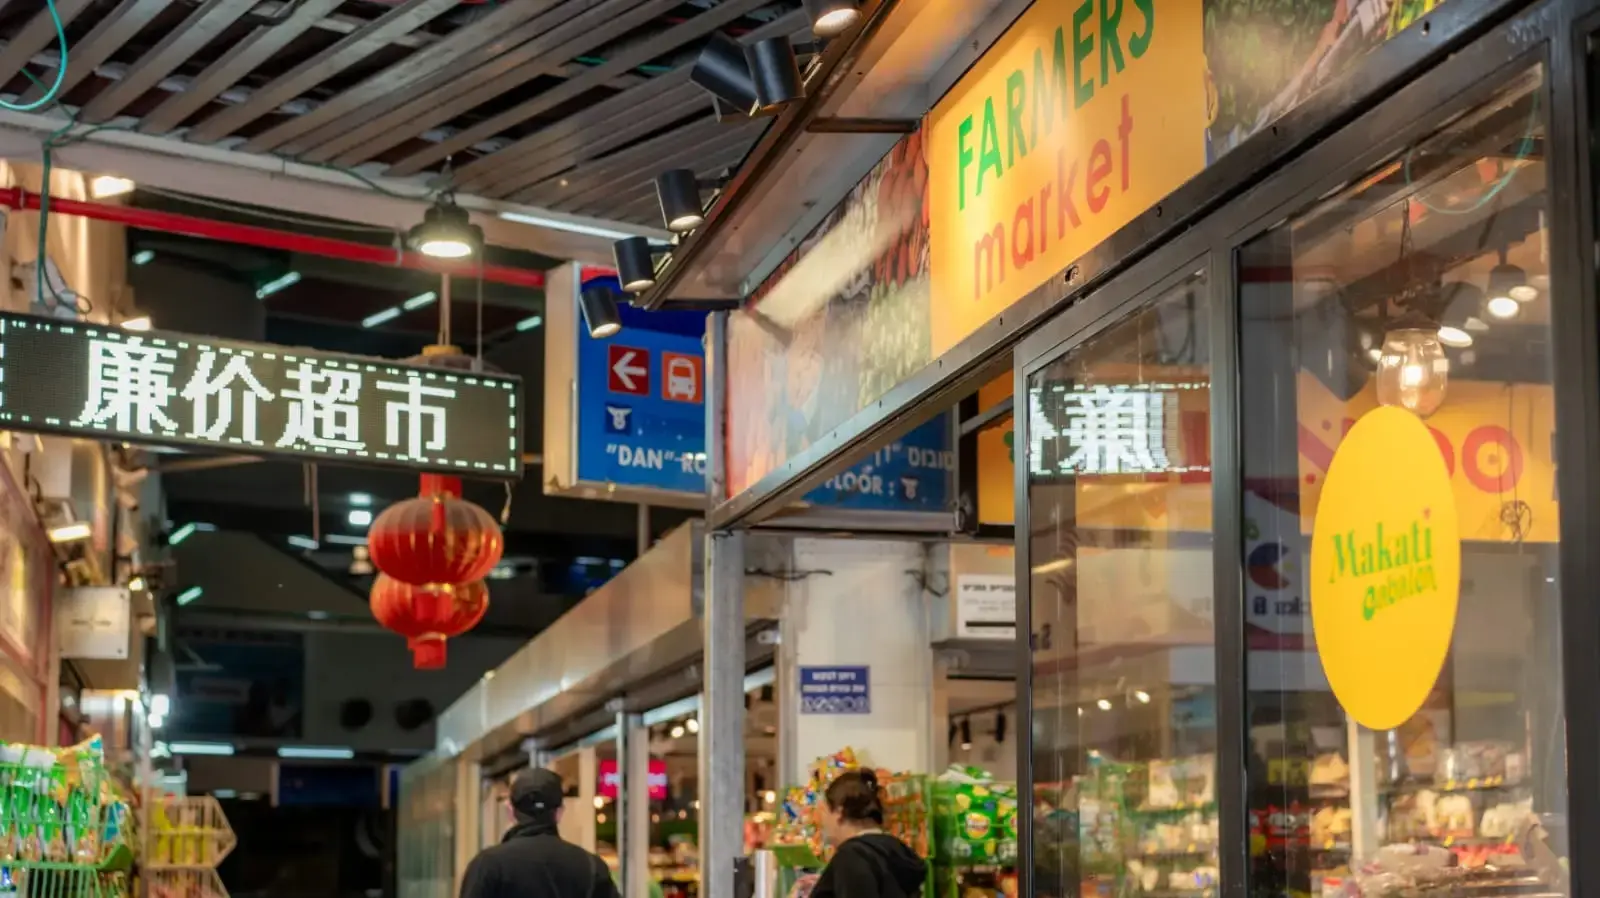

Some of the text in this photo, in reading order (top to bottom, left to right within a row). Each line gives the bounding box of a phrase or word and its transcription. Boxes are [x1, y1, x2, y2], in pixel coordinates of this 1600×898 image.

[958, 0, 1154, 211] FARMERS
[973, 93, 1134, 301] market
[78, 337, 457, 461] 廉价超市
[1329, 507, 1432, 584] Makati
